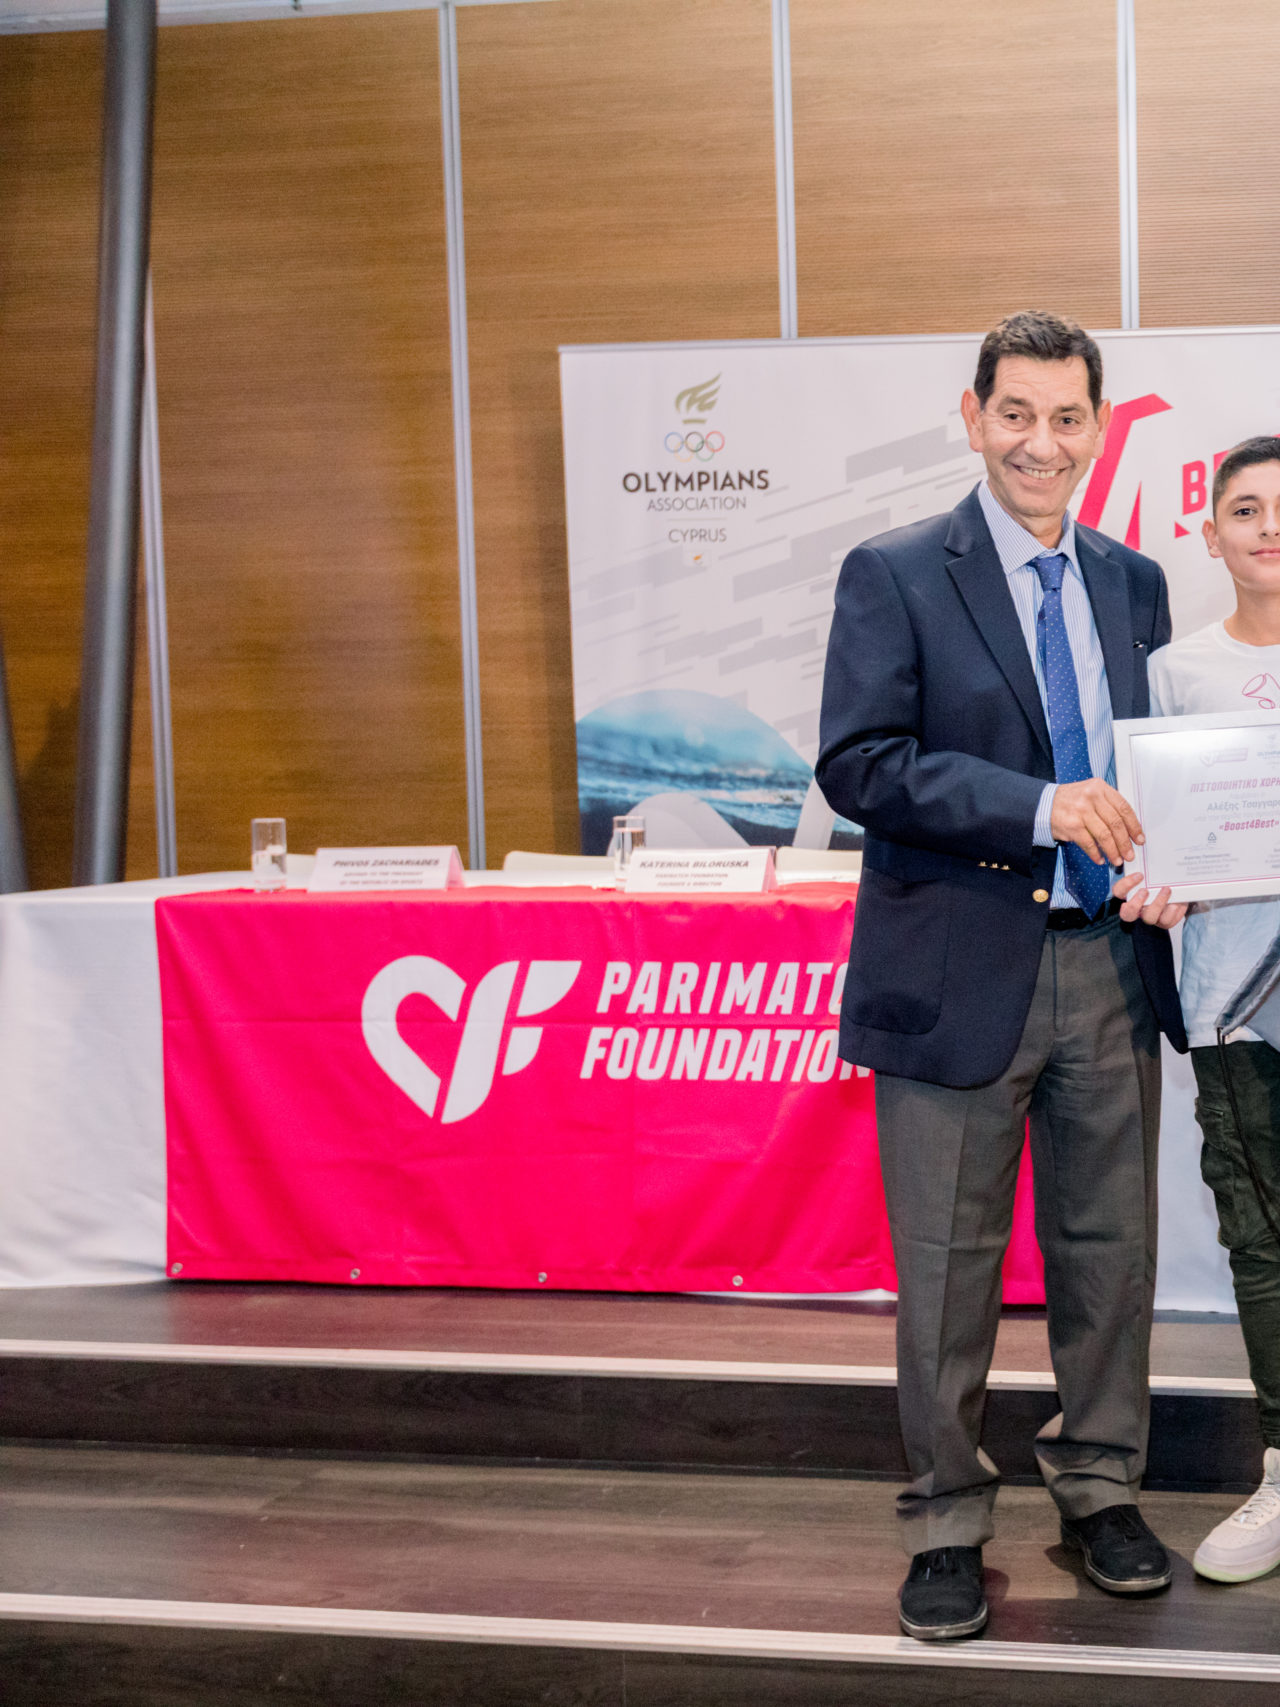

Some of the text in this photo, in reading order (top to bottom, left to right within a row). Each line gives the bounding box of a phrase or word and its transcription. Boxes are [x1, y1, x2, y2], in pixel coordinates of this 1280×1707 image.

[622, 469, 770, 493] OLYMPIANS
[647, 496, 747, 512] ASSOCIATION
[668, 528, 727, 543] CYPRUS
[640, 860, 689, 868] KATERINA
